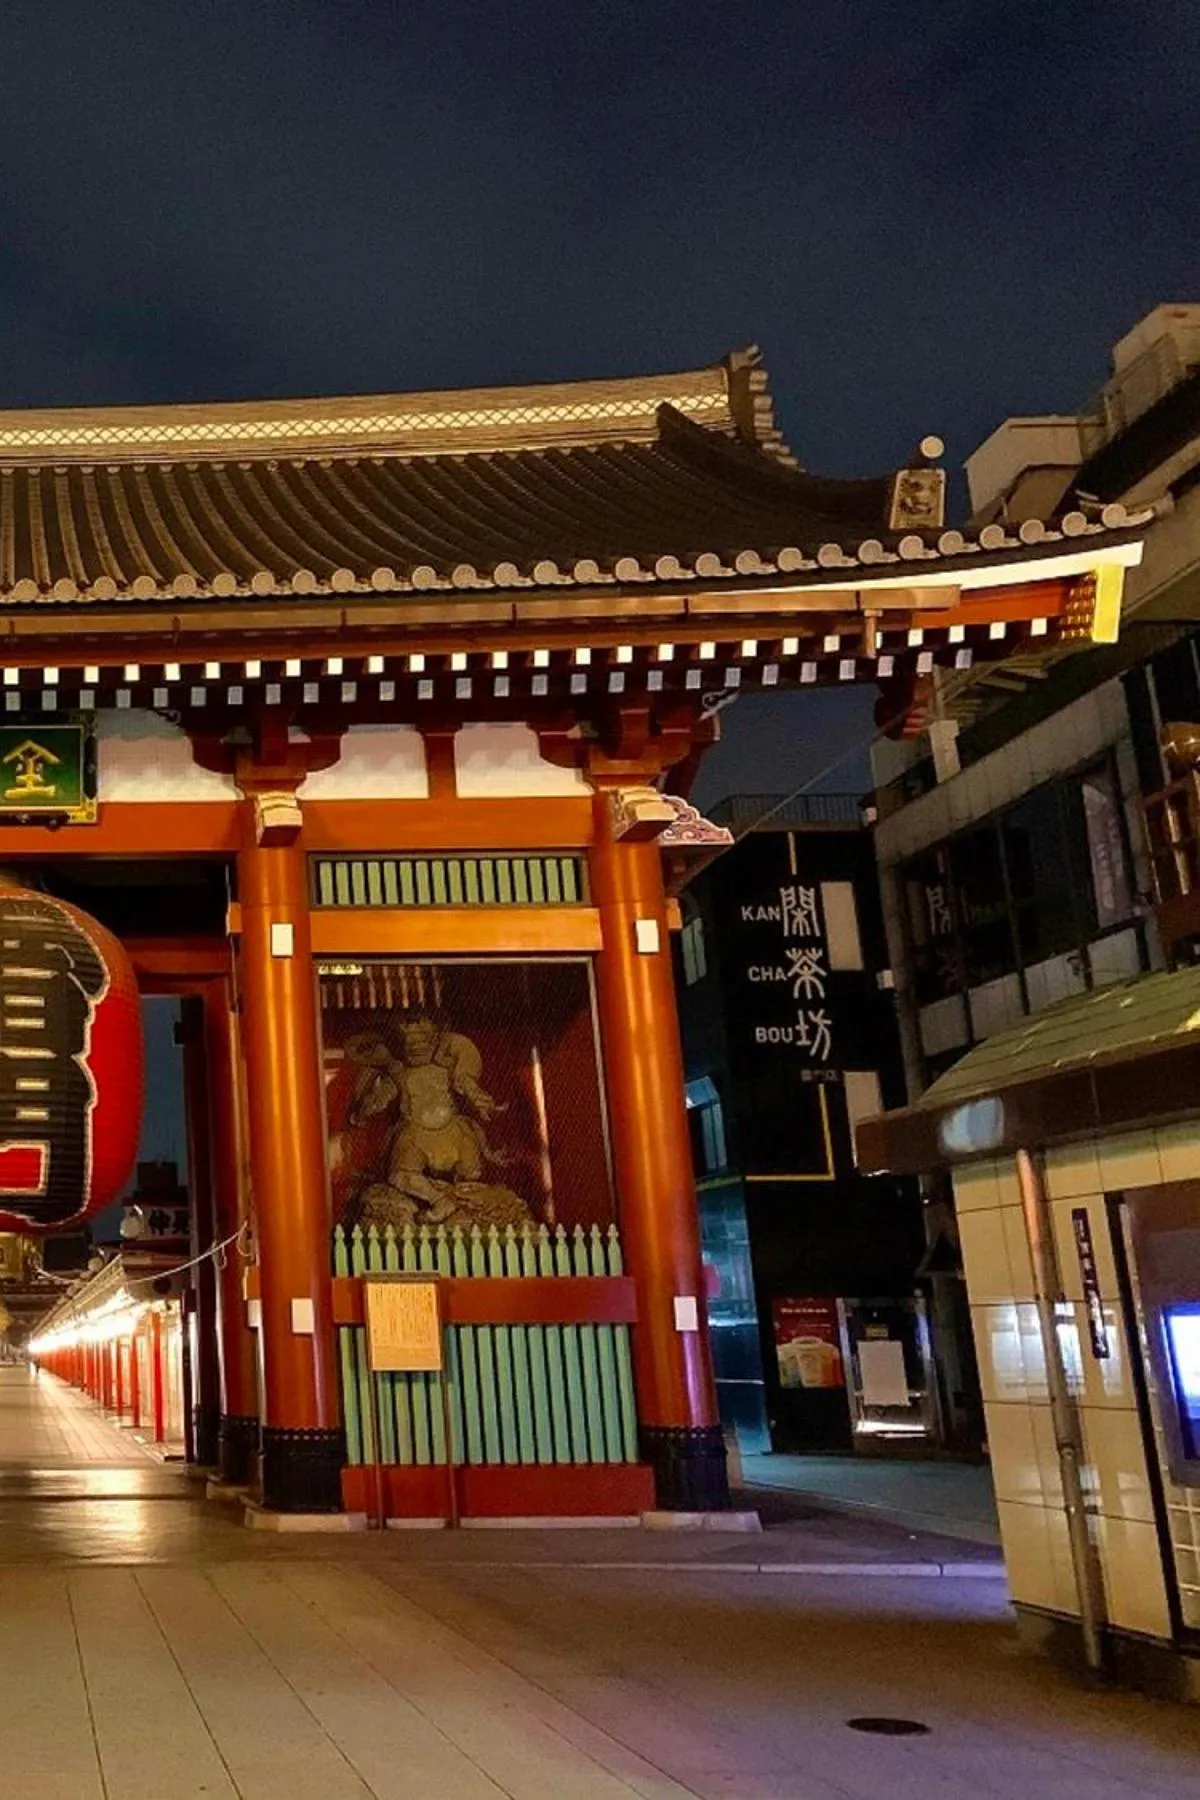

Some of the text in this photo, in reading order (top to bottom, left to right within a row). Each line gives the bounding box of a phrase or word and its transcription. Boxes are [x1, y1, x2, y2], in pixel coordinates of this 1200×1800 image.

[741, 905, 781, 922] KAN
[748, 966, 788, 982] CHA
[755, 1027, 794, 1044] BOU
